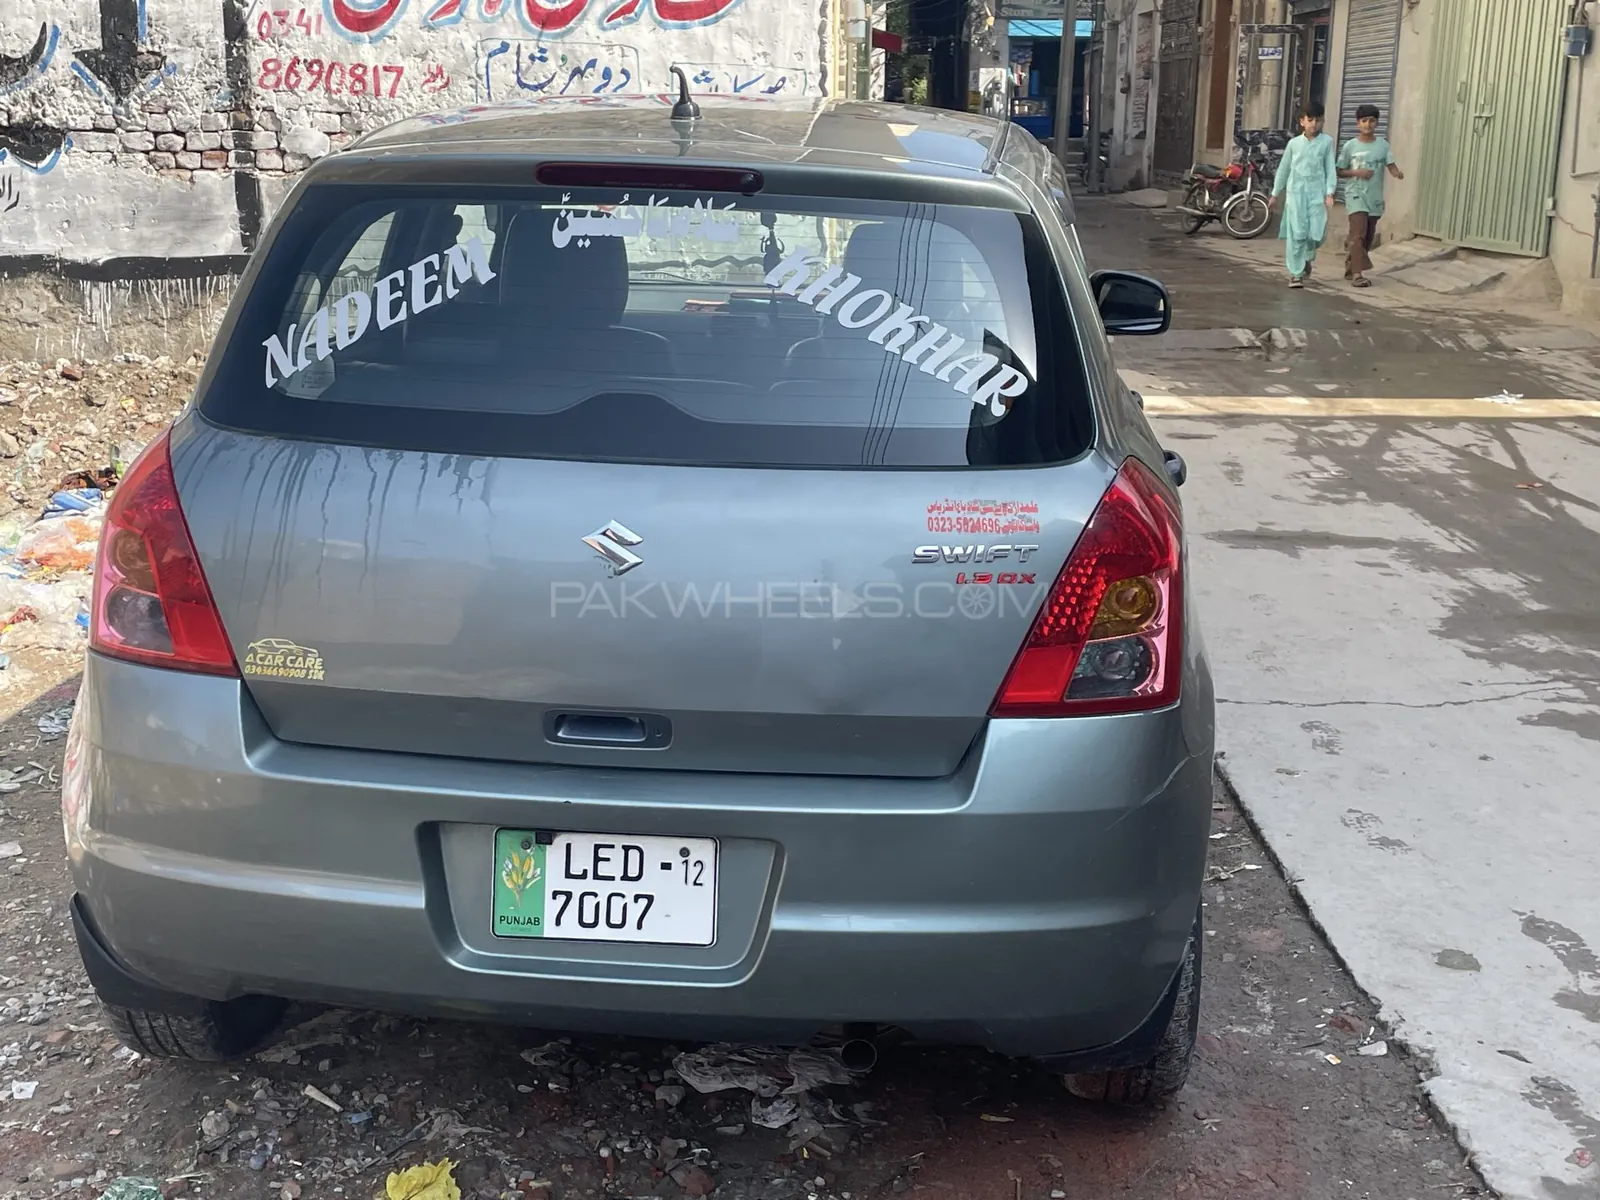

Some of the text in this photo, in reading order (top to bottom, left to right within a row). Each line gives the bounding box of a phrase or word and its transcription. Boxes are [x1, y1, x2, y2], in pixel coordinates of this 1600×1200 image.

[258, 56, 404, 99] 8690817
[262, 237, 497, 390] NADEEM
[764, 246, 1029, 418] KHOKHAR
[911, 544, 1039, 564] SWIFT
[286, 656, 323, 670] CARE
[564, 842, 644, 882] LED
[499, 914, 541, 927] PUNJAB
[551, 889, 655, 931] 7007
